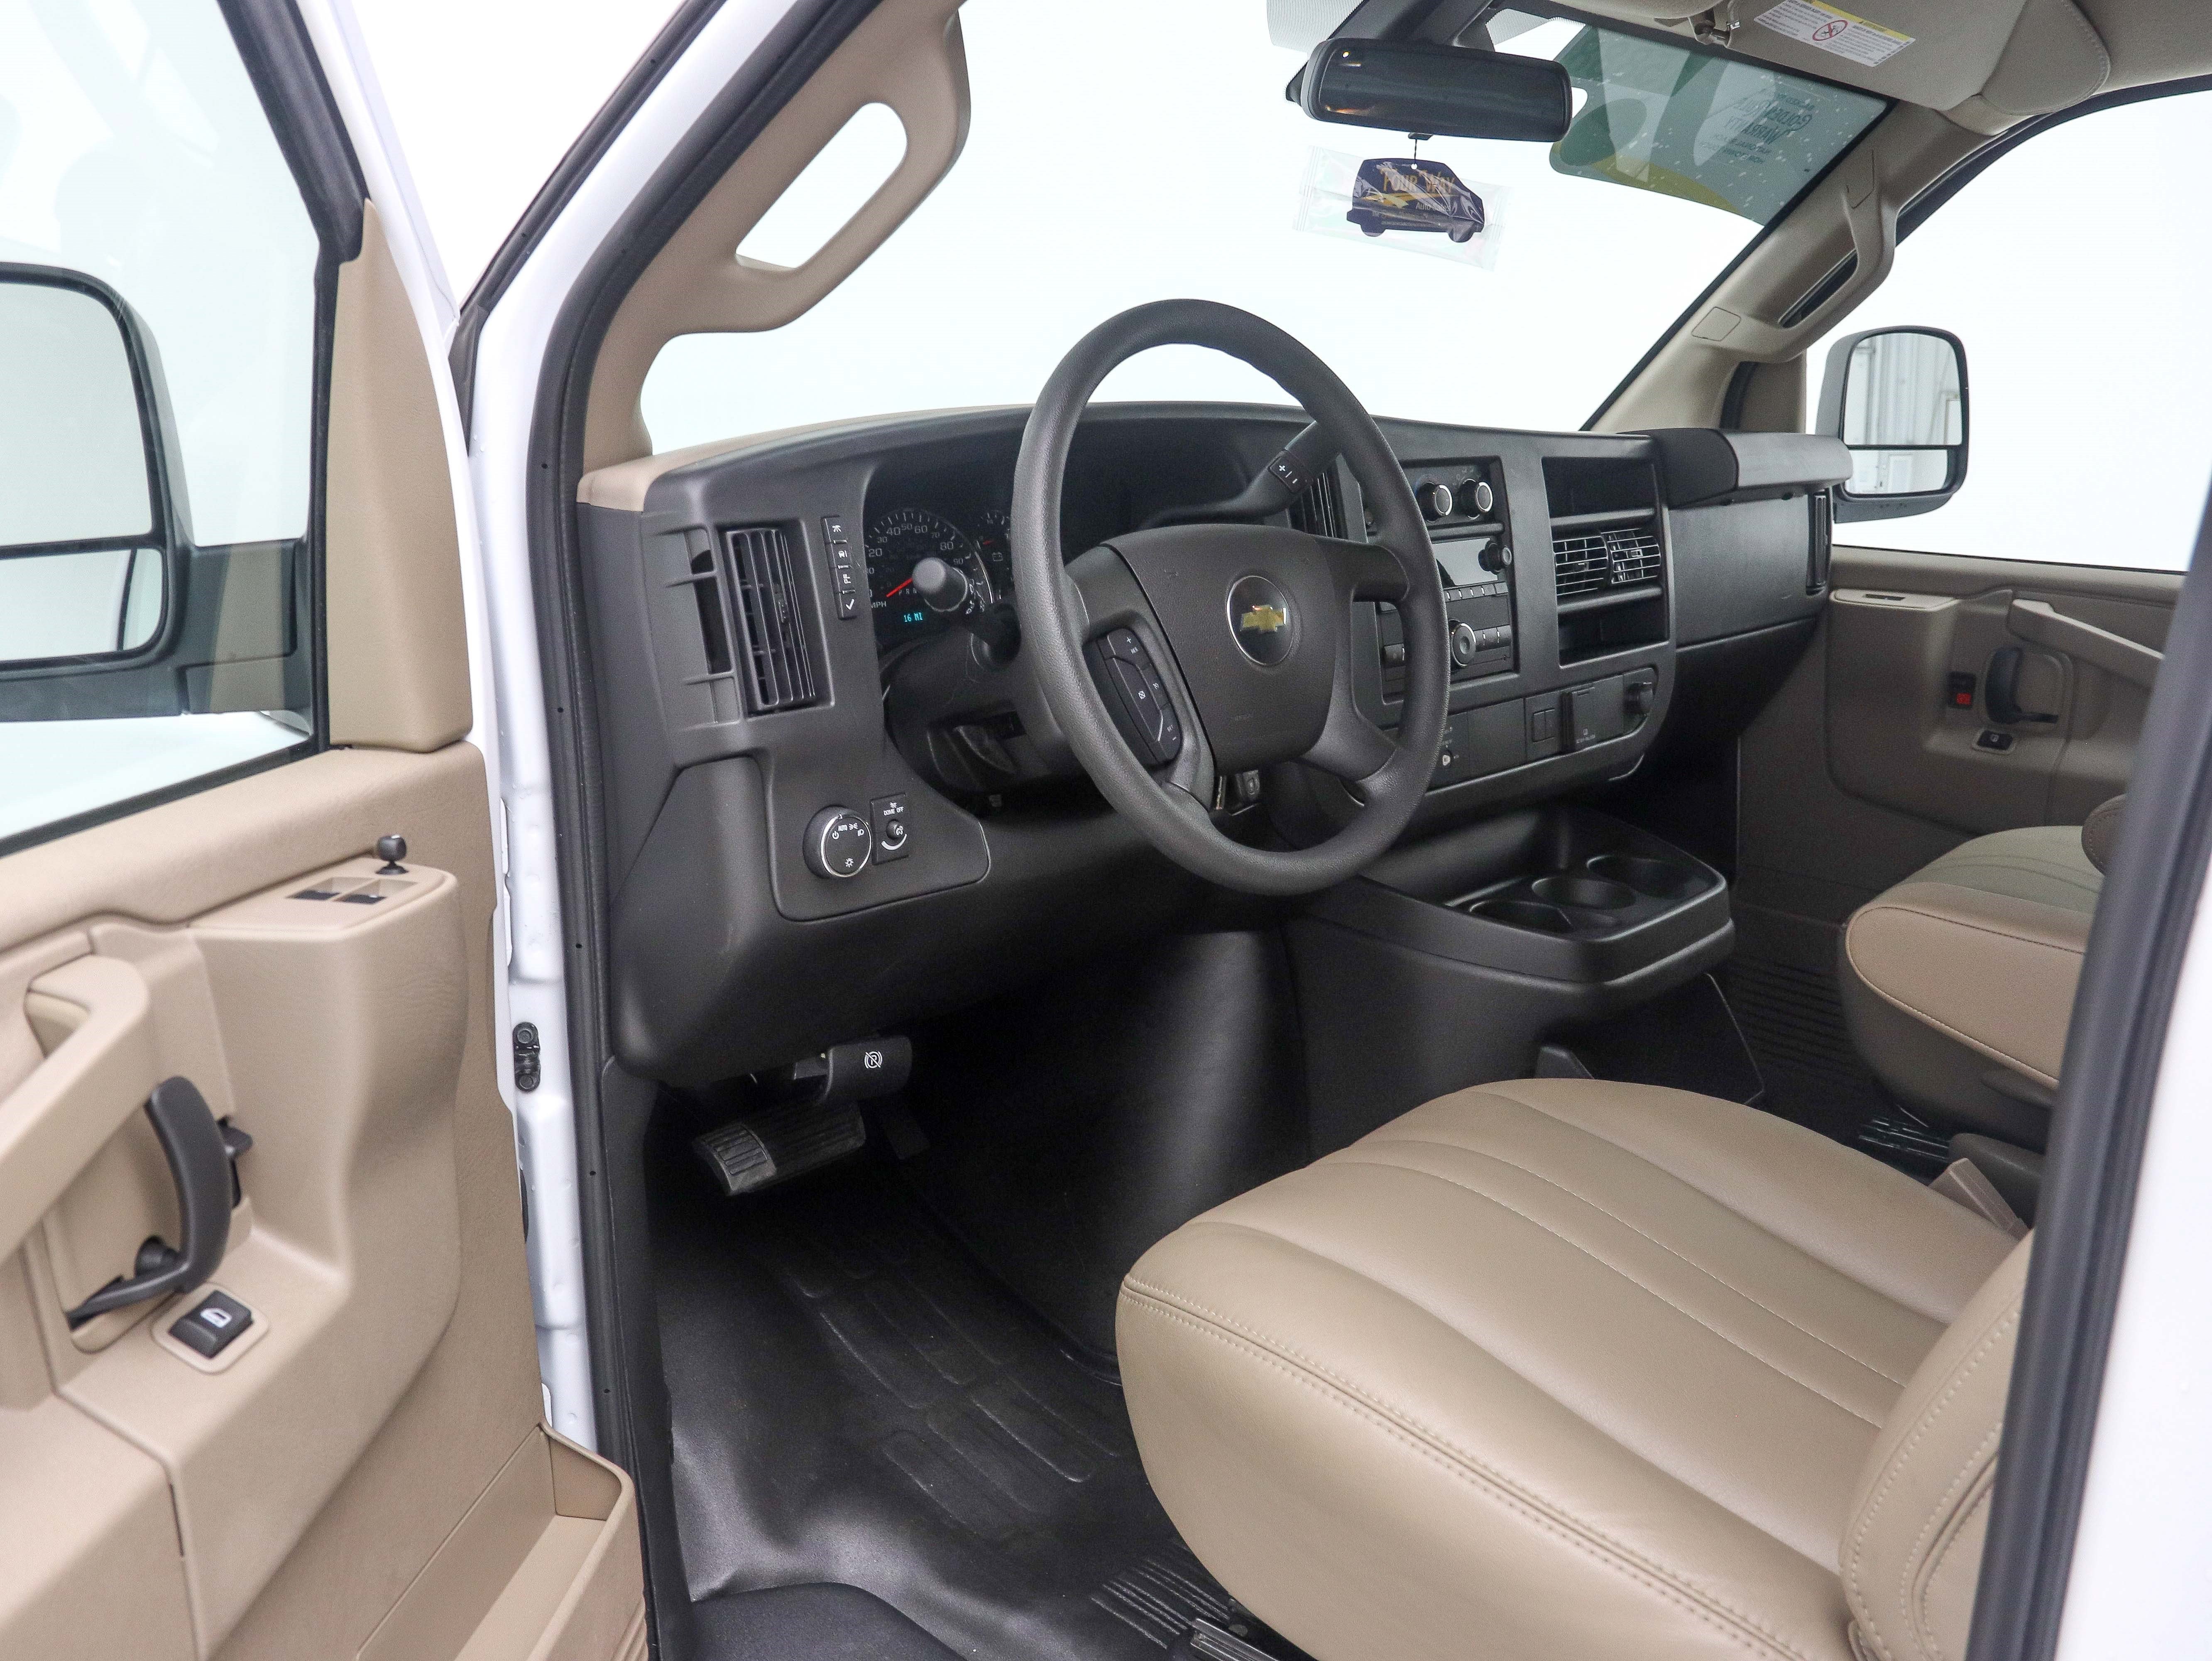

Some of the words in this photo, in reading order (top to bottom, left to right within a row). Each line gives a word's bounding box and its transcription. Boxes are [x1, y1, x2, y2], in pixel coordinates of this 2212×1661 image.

[886, 527, 901, 535] 40
[915, 525, 927, 534] 60
[940, 541, 954, 550] 80
[869, 549, 883, 557] 20
[904, 614, 911, 622] 16
